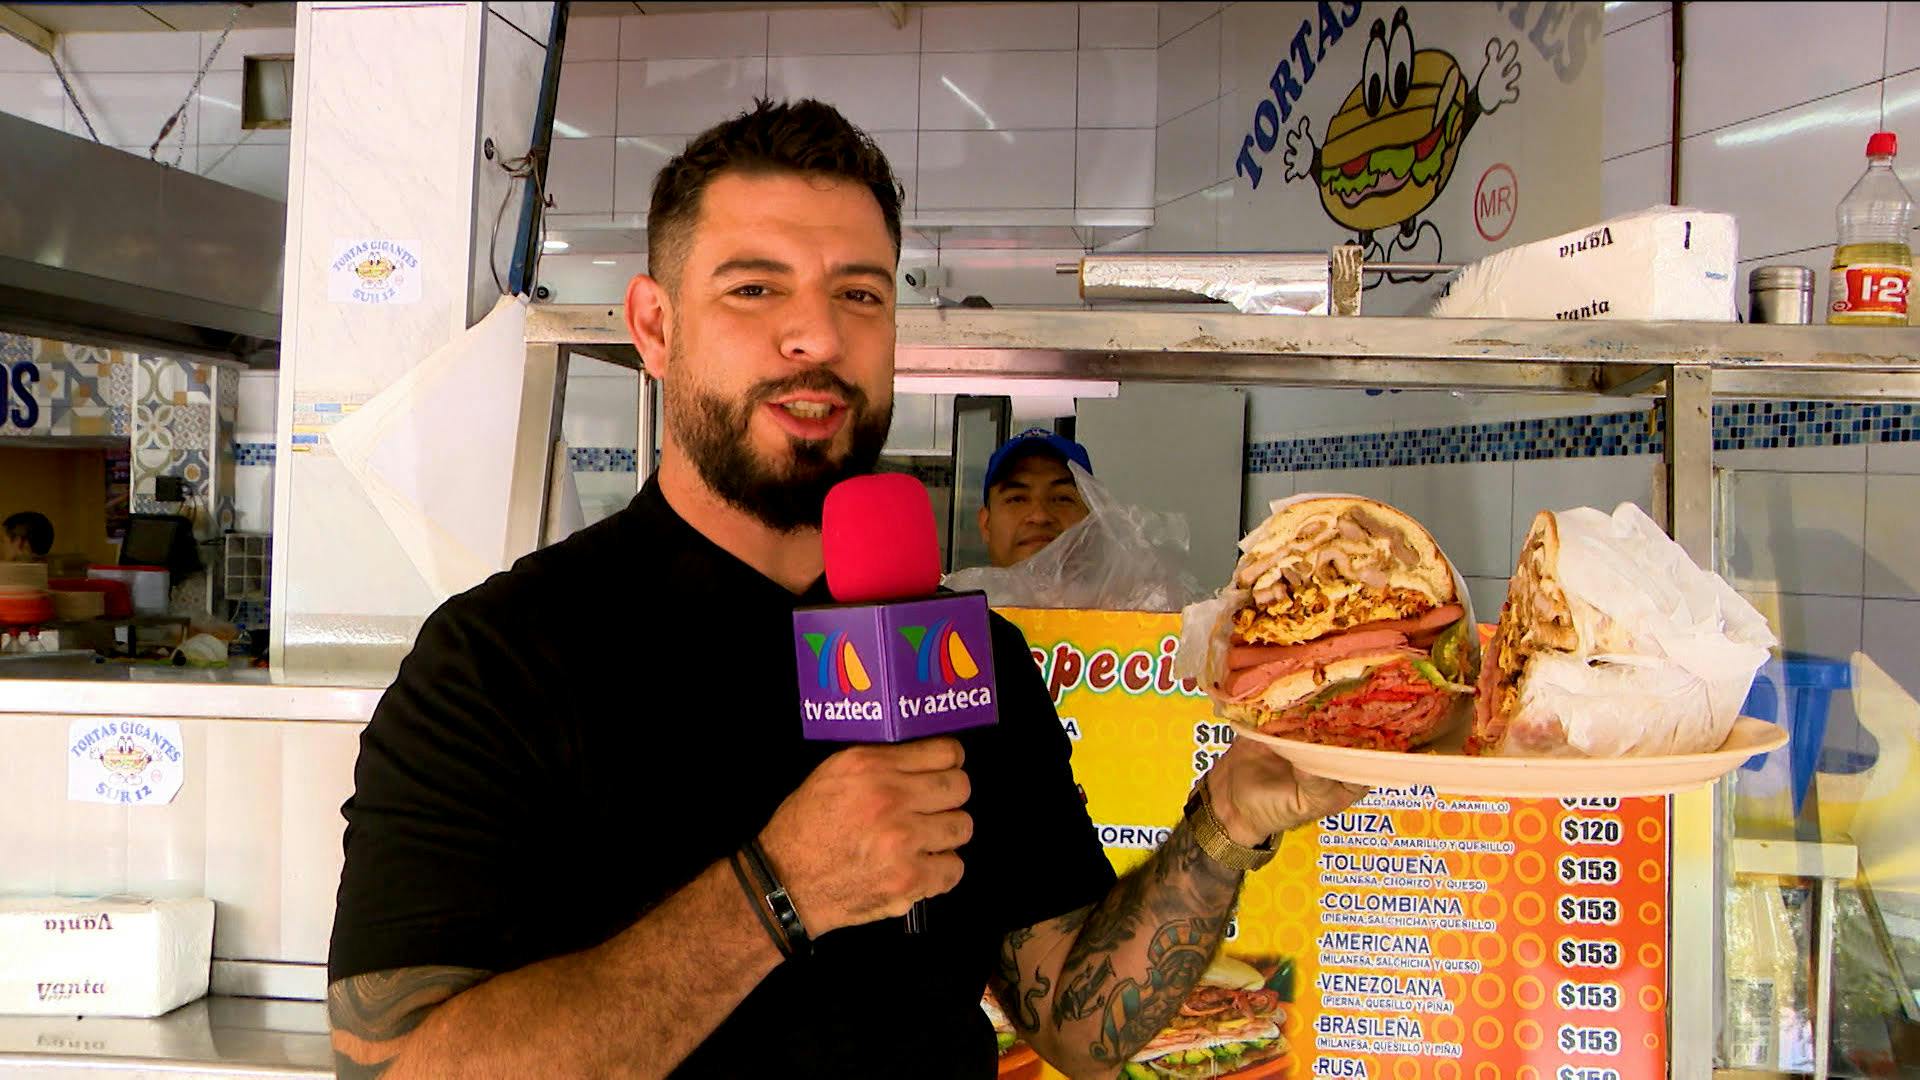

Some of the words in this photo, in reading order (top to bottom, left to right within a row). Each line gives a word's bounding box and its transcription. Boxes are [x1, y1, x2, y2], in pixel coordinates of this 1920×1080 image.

[1480, 187, 1512, 219] MR
[804, 698, 822, 721] tv
[825, 698, 883, 721] azteca
[899, 695, 921, 718] tv
[924, 687, 991, 715] azteca
[71, 723, 117, 757] TORTAS
[120, 721, 180, 762] GIGANTES
[136, 785, 152, 800] 12
[1426, 801, 1433, 809] Y
[1564, 819, 1619, 842] $120
[1393, 840, 1447, 850] AMARILLO
[1561, 858, 1617, 881] $153
[1383, 876, 1431, 888] CHORIZO
[1436, 879, 1443, 888] Y
[1447, 880, 1486, 890] QUESO)
[1561, 897, 1617, 921] $153
[1376, 956, 1430, 969] SALCHICHA
[1434, 960, 1441, 969] Y
[1444, 960, 1481, 972] QUESO)
[1561, 941, 1617, 964] $153
[1366, 998, 1412, 1010] QUESILLO
[1416, 1001, 1423, 1010] Y
[1561, 984, 1617, 1008] $153
[1373, 1041, 1420, 1053] QUESILLO
[1425, 1043, 1431, 1052] Y
[1561, 1027, 1617, 1052] $153
